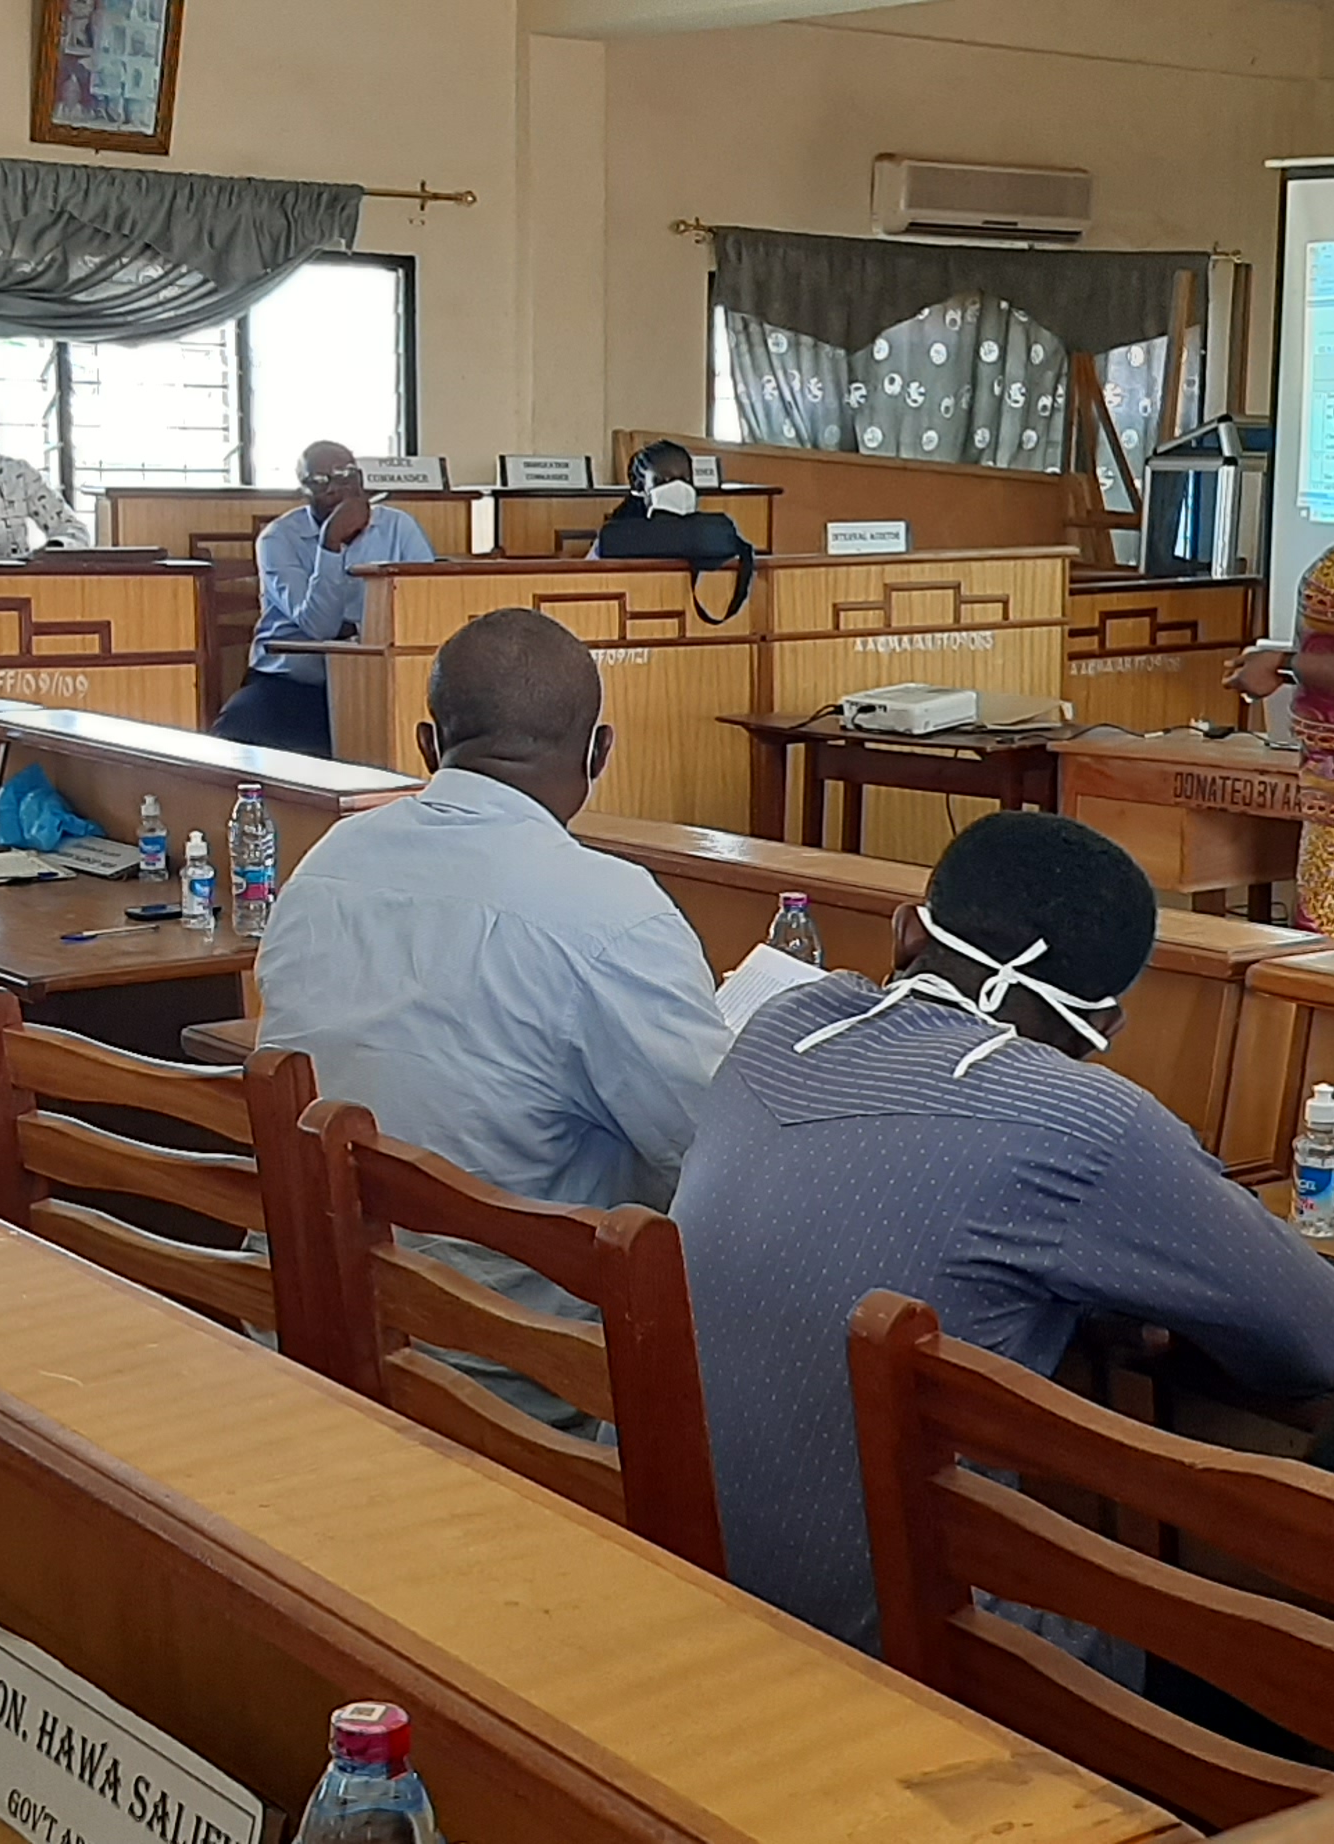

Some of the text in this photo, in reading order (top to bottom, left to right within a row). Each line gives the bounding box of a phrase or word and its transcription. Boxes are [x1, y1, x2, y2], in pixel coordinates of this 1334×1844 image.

[1173, 771, 1255, 808] DONATED
[1257, 780, 1279, 809] BY
[35, 1708, 122, 1809] HAWA
